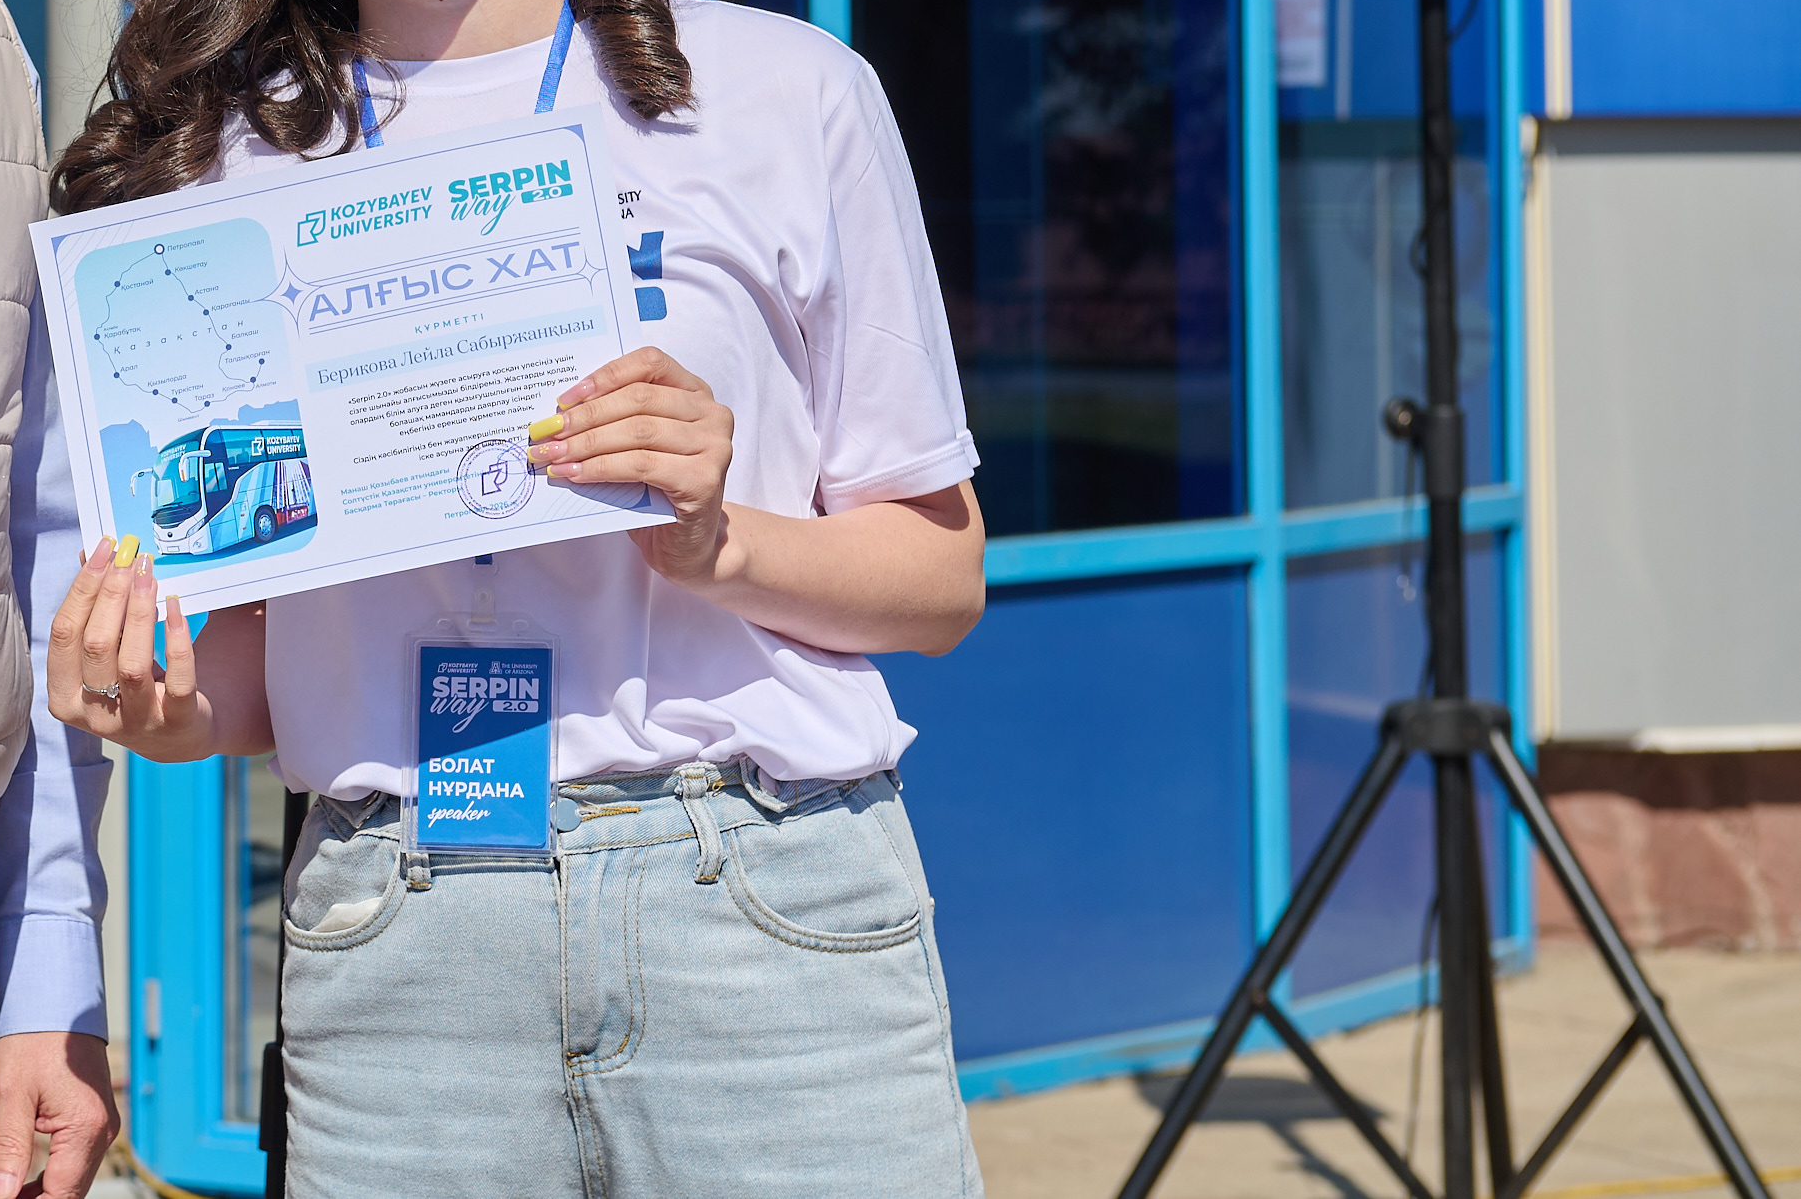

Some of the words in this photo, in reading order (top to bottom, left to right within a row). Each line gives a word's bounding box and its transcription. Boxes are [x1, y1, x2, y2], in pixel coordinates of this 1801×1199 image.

[448, 159, 571, 204] SERPIN
[331, 186, 432, 222] KOZYBAYEV
[617, 190, 642, 205] SITY
[450, 192, 516, 236] way
[532, 186, 562, 202] 2.0
[330, 205, 432, 240] UNIVERSITY
[167, 239, 205, 252] Петропавл
[194, 285, 219, 295] Астана
[309, 263, 474, 322] АЛҒЫС
[487, 241, 580, 284] ХАТ
[318, 358, 397, 384] Берикова
[400, 346, 454, 368] Лейла
[457, 318, 595, 354] Сабыржанқызы
[120, 364, 138, 373] Арал
[194, 393, 215, 402] Тараз
[267, 436, 300, 445] KOZYBAYEV
[267, 443, 301, 454] UNIVERSITY
[432, 676, 539, 699] SERPIN
[430, 693, 489, 733] way
[503, 701, 528, 711] 2.0
[429, 758, 495, 774] БОЛАТ
[429, 781, 524, 799] НҰРДАНА
[428, 801, 491, 828] speaker
